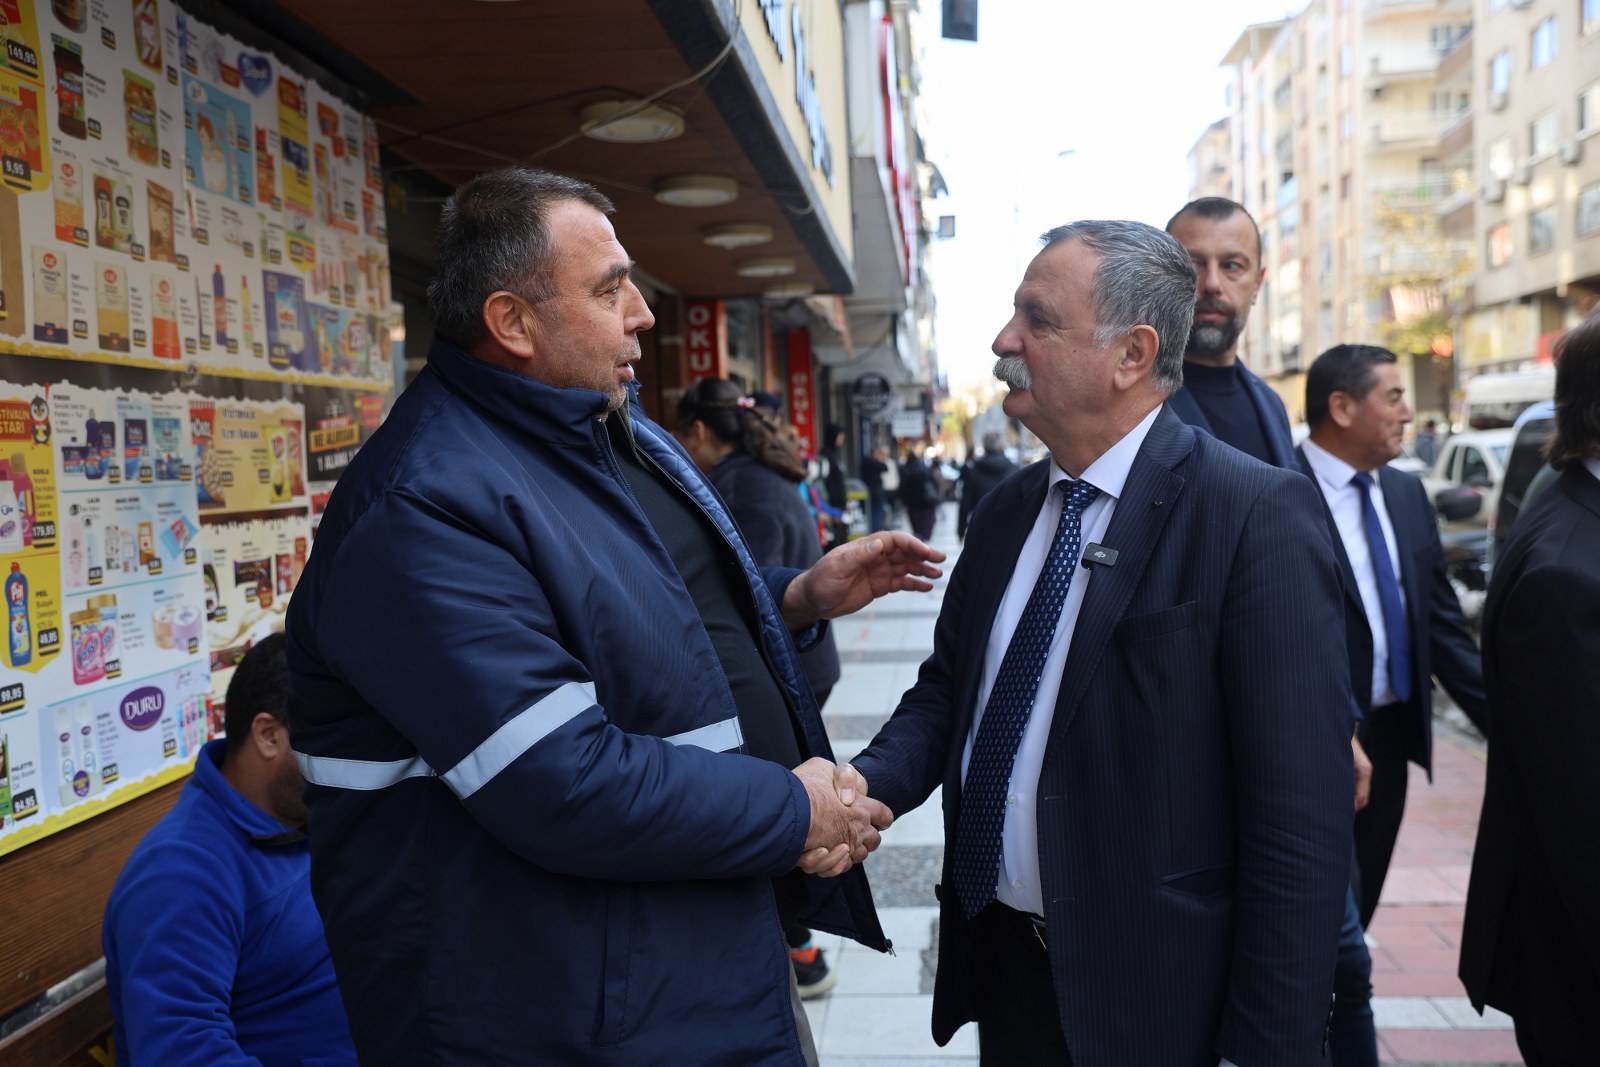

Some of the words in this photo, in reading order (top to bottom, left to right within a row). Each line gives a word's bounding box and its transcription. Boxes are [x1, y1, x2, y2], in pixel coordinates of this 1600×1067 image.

[6, 160, 24, 176] 9,95
[689, 305, 712, 382] OKU
[125, 693, 162, 721] DURU
